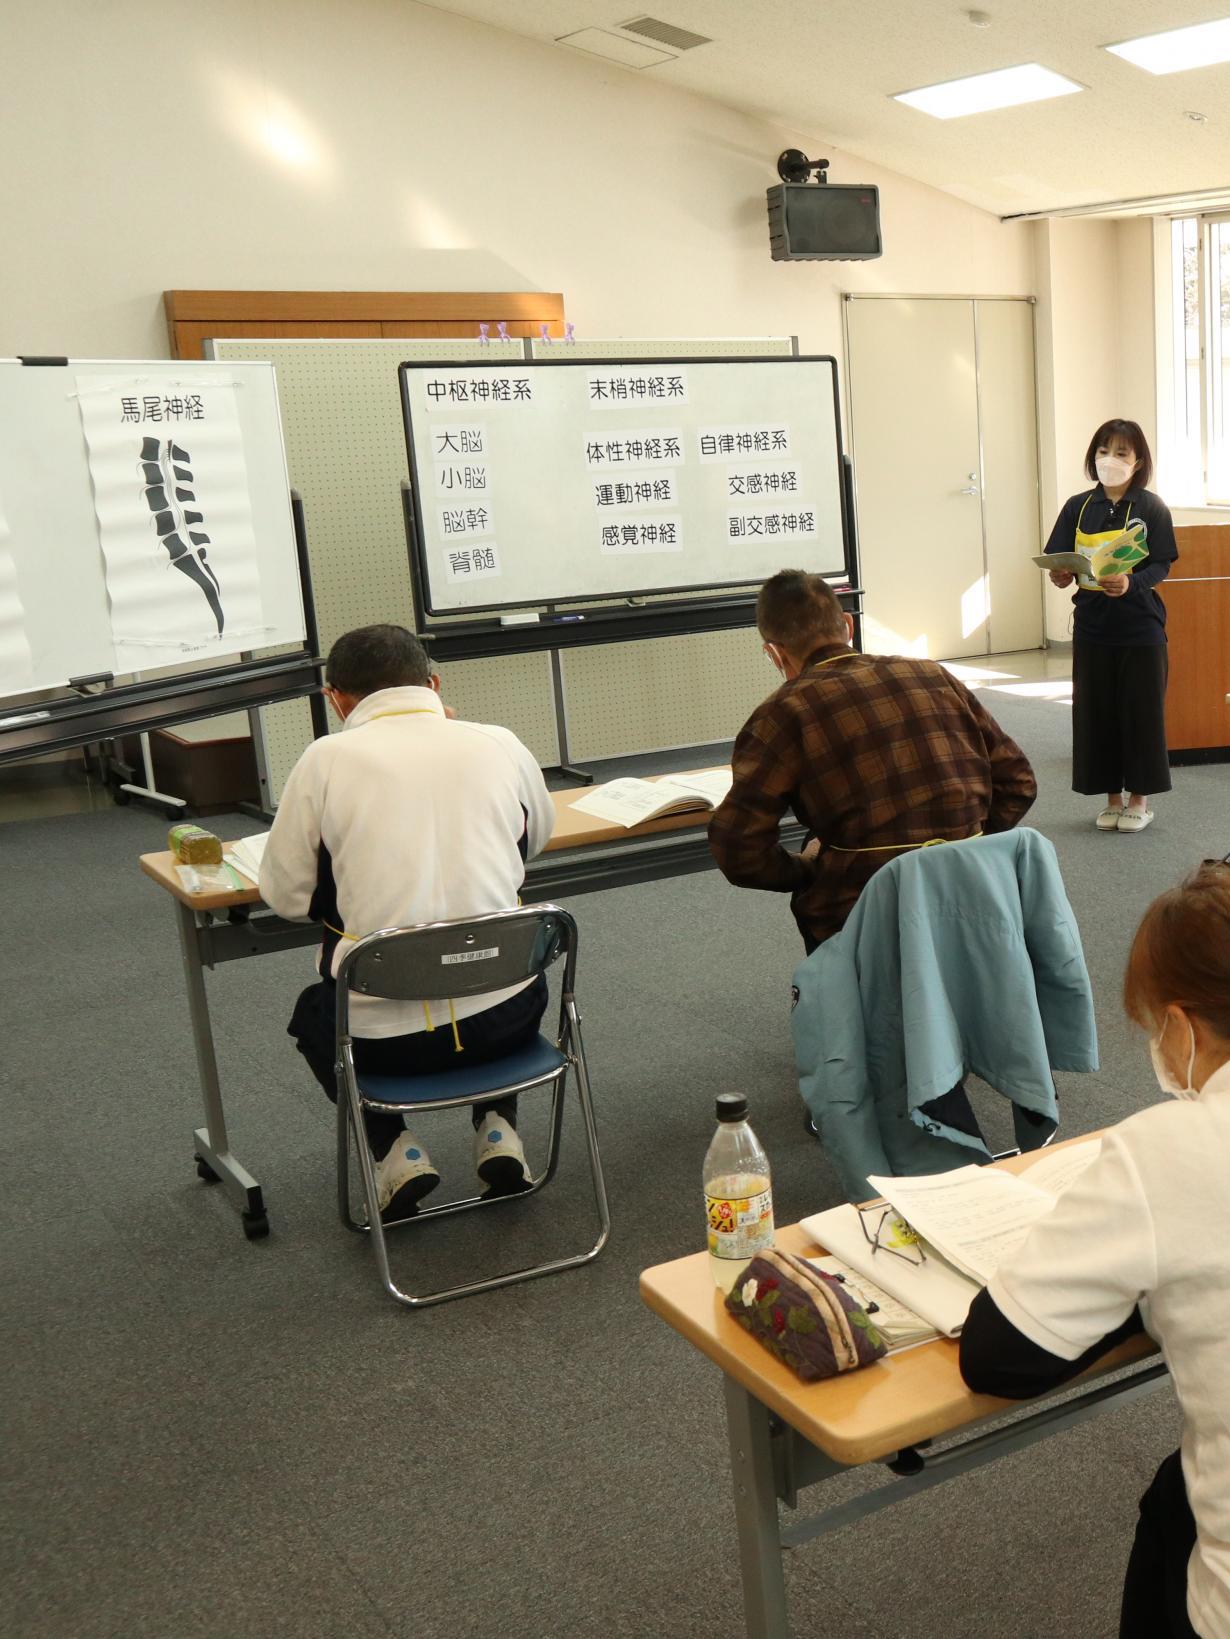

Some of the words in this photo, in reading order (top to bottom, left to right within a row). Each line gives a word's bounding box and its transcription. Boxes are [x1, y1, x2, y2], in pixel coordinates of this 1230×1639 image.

[427, 379, 531, 402] 中枢神経系
[589, 376, 684, 400] 末梢神経系
[121, 395, 205, 423] 馬尾神経
[436, 431, 482, 453] 大脳
[586, 437, 680, 464] 体性神経系
[701, 430, 787, 455] 自律神経系
[441, 467, 486, 489] 小脳
[728, 472, 797, 495] 交感神経
[595, 480, 671, 506] 運動神経
[443, 506, 488, 533] 脳幹
[728, 512, 815, 537] 副交感神経
[602, 523, 676, 546] 感覚神経
[449, 547, 495, 574] 脊髄
